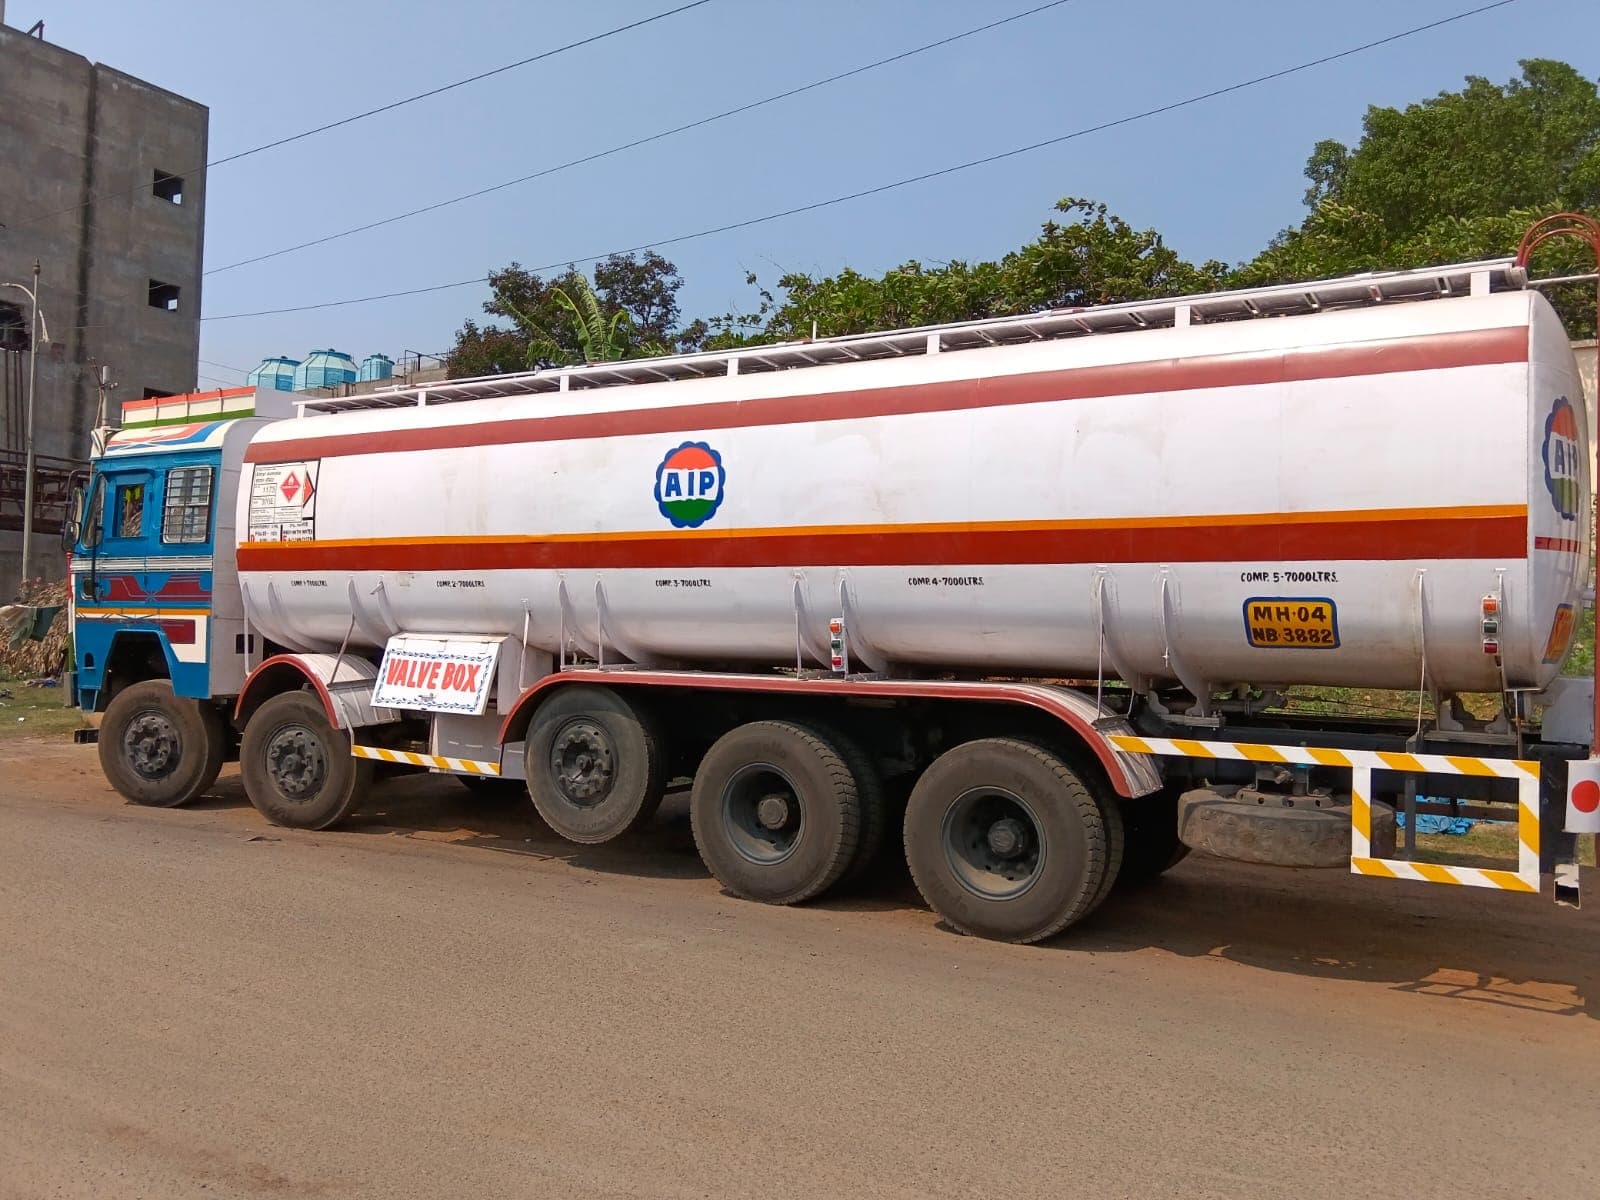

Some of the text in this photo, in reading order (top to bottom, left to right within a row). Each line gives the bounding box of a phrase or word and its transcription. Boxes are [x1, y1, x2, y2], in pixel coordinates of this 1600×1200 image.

[664, 471, 715, 497] AIP
[385, 658, 481, 693] VALVE BOX
